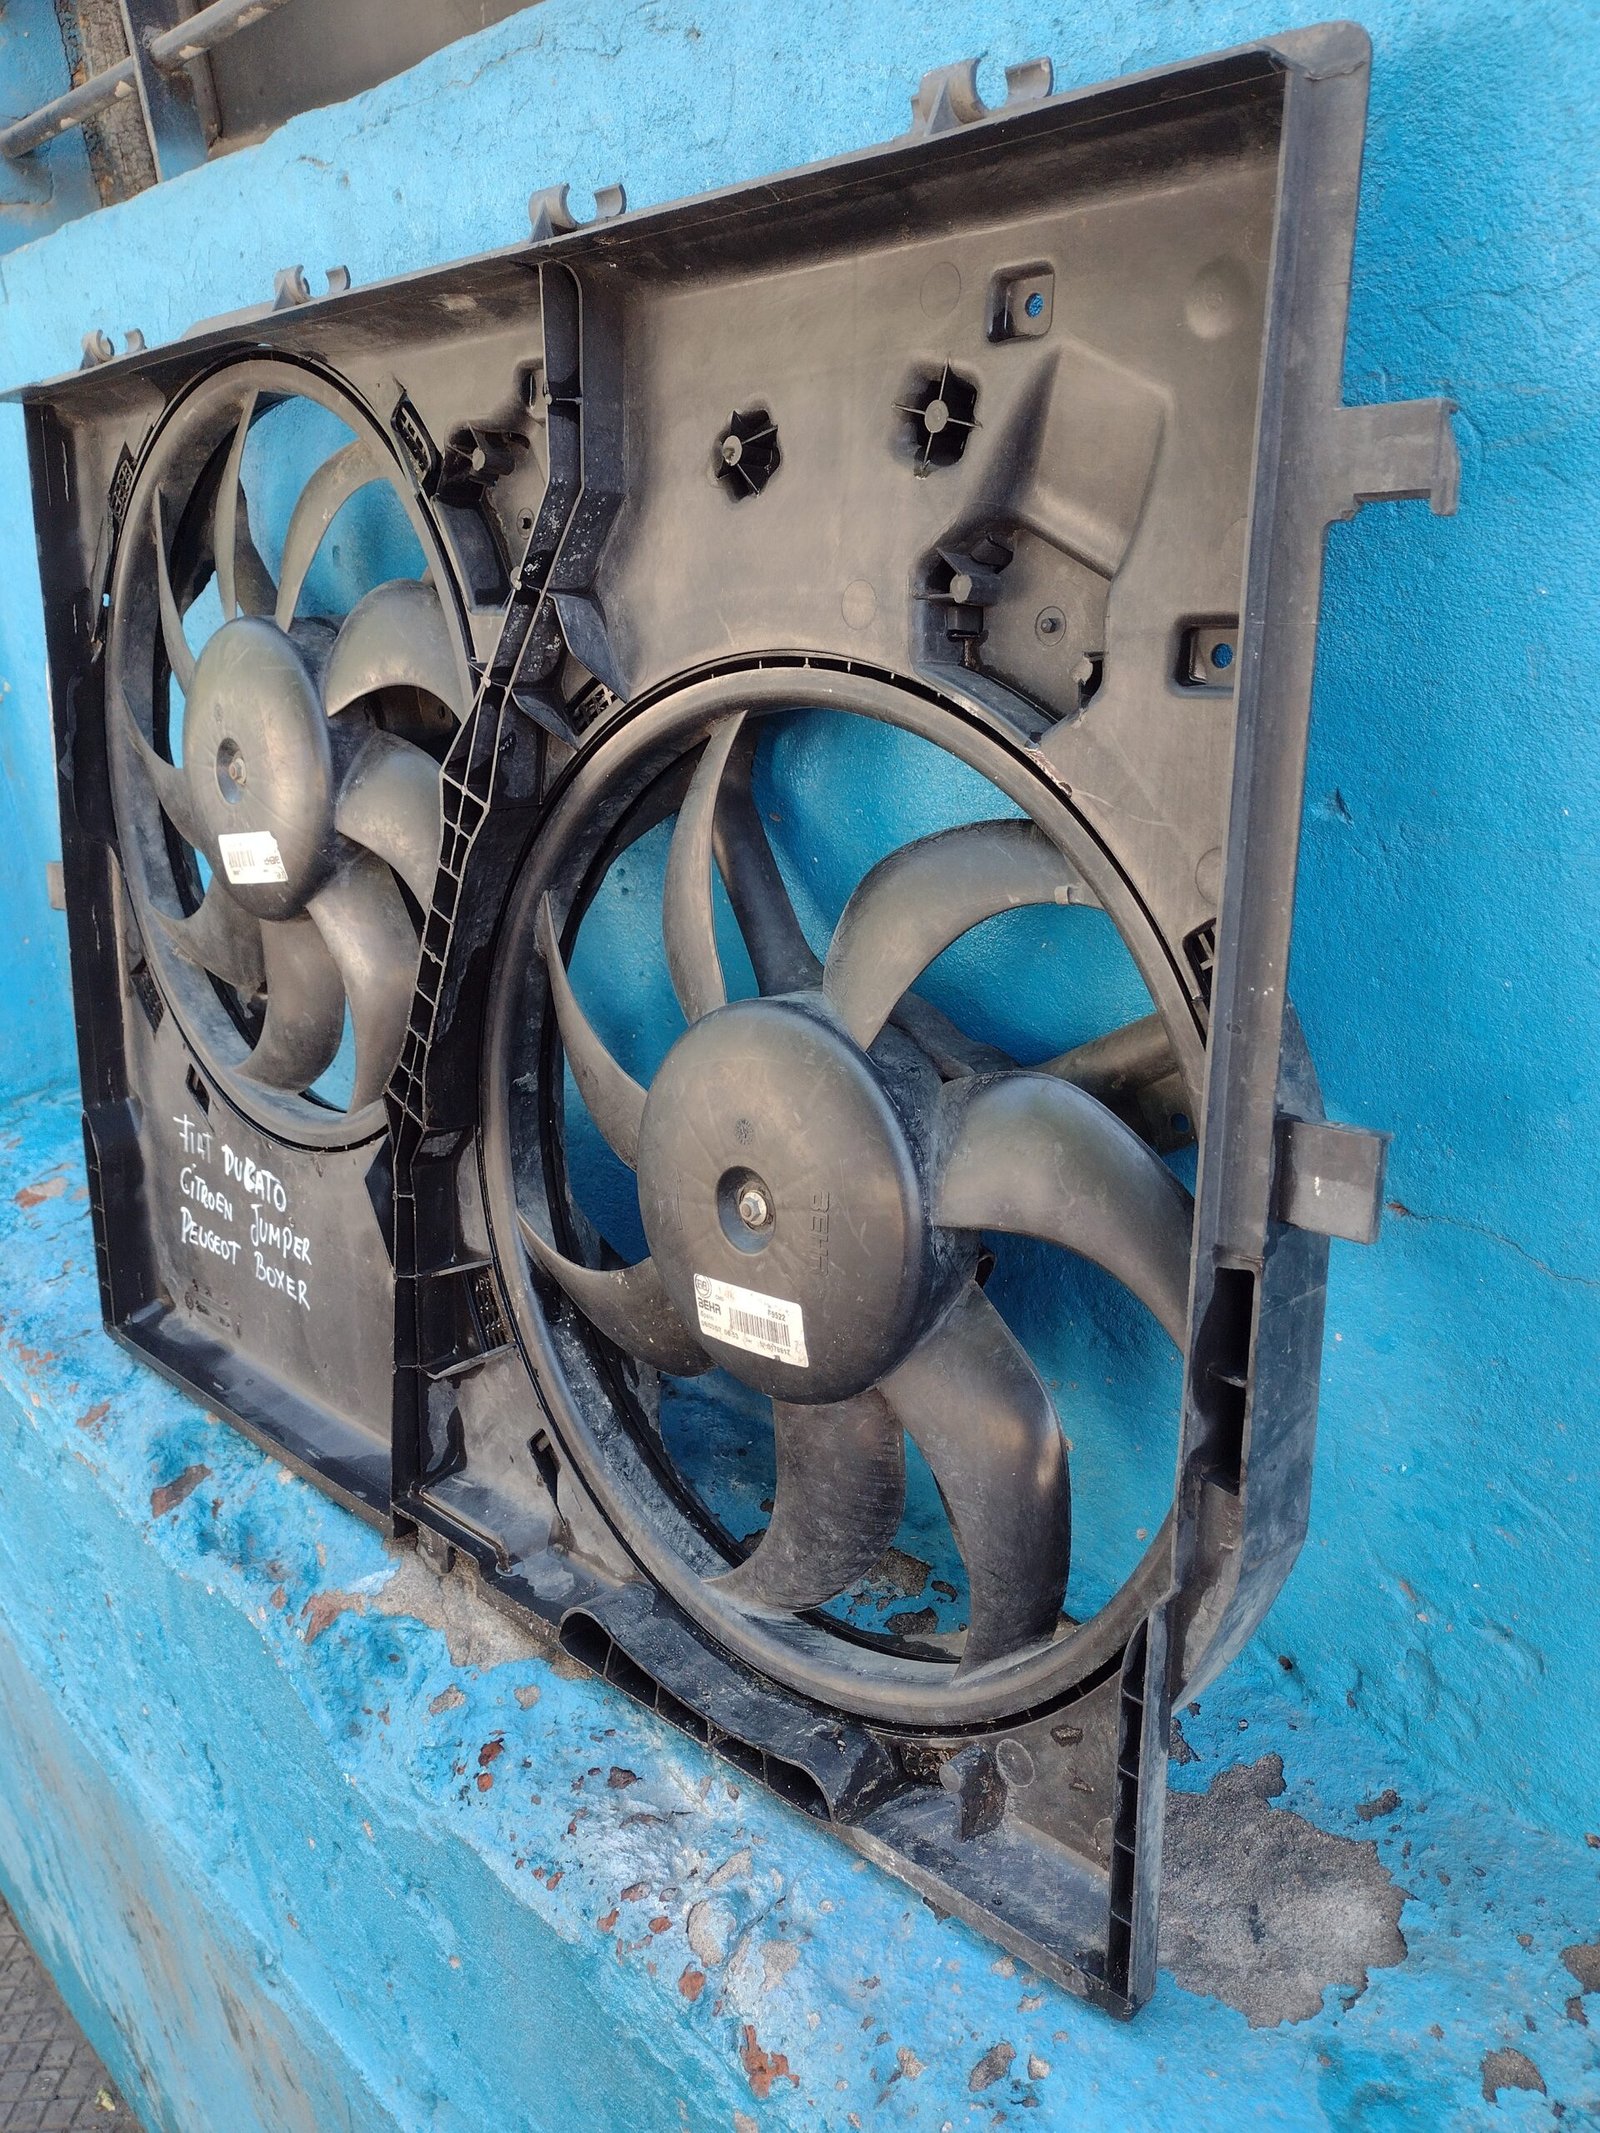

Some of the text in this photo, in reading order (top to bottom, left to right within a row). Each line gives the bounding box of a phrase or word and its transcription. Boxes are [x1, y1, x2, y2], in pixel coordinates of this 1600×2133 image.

[173, 1114, 213, 1163] FIAT
[180, 1206, 241, 1265] PEUGEOT
[254, 1250, 311, 1311] BOXER
[250, 1203, 312, 1265] JUMPER
[698, 1297, 722, 1316] BEHR
